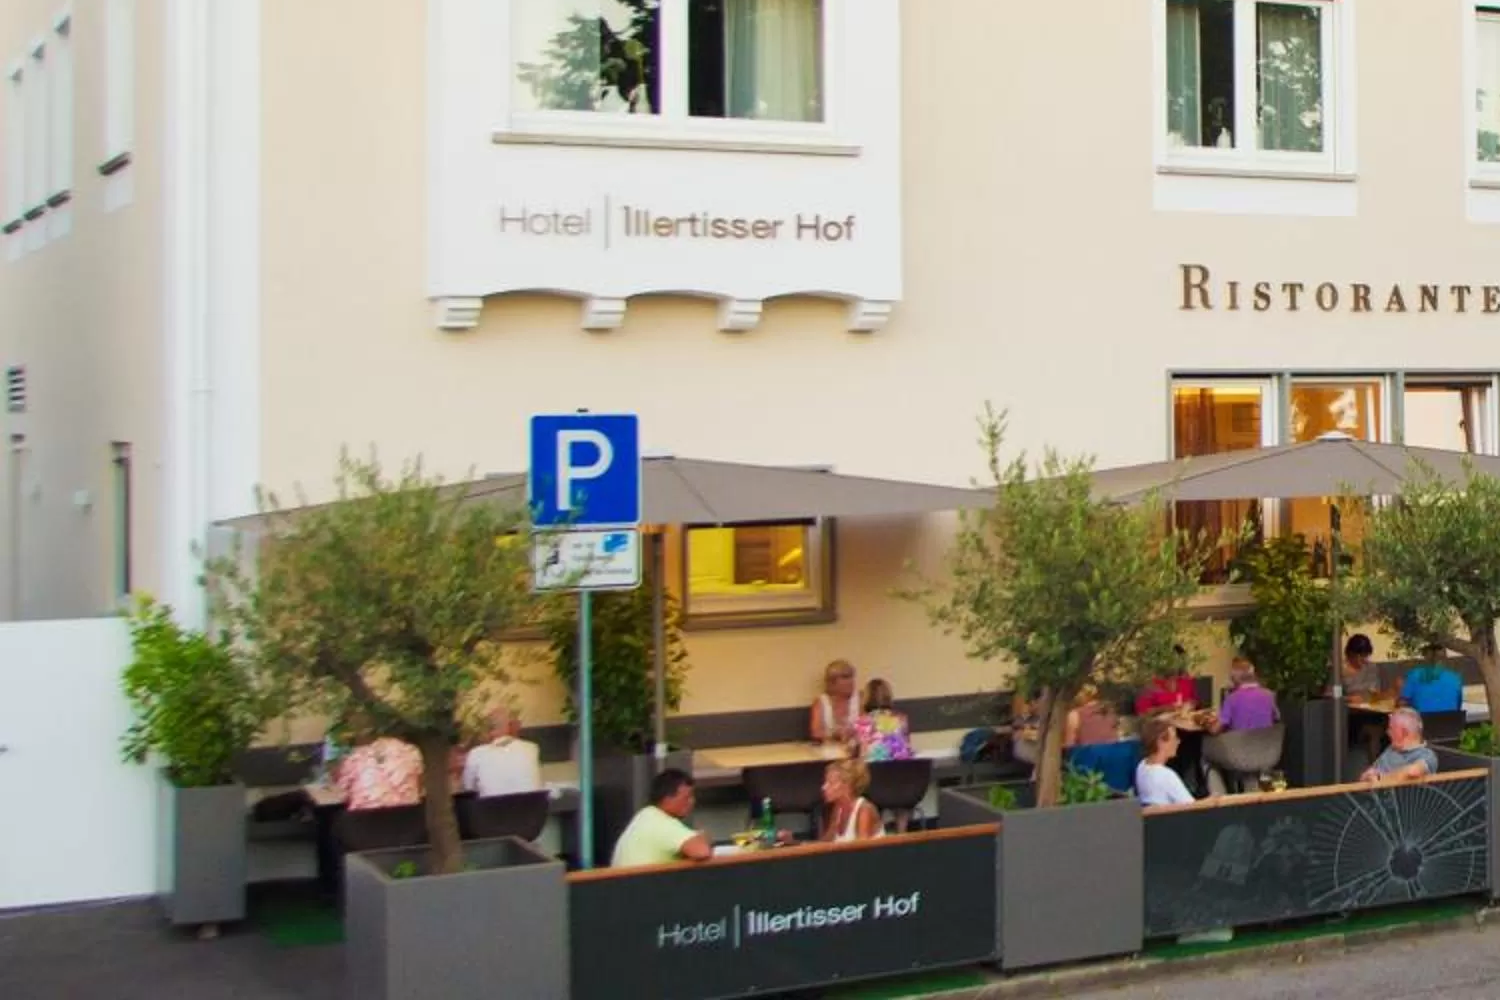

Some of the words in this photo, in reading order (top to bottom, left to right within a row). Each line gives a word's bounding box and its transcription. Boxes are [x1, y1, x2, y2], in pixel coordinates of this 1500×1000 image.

[501, 206, 590, 237] Hotel
[621, 206, 783, 241] Illertisser
[796, 214, 856, 243] Hof
[556, 429, 615, 512] P
[657, 915, 727, 949] Hotel
[747, 904, 869, 937] Illertisser
[873, 891, 921, 920] Hof
